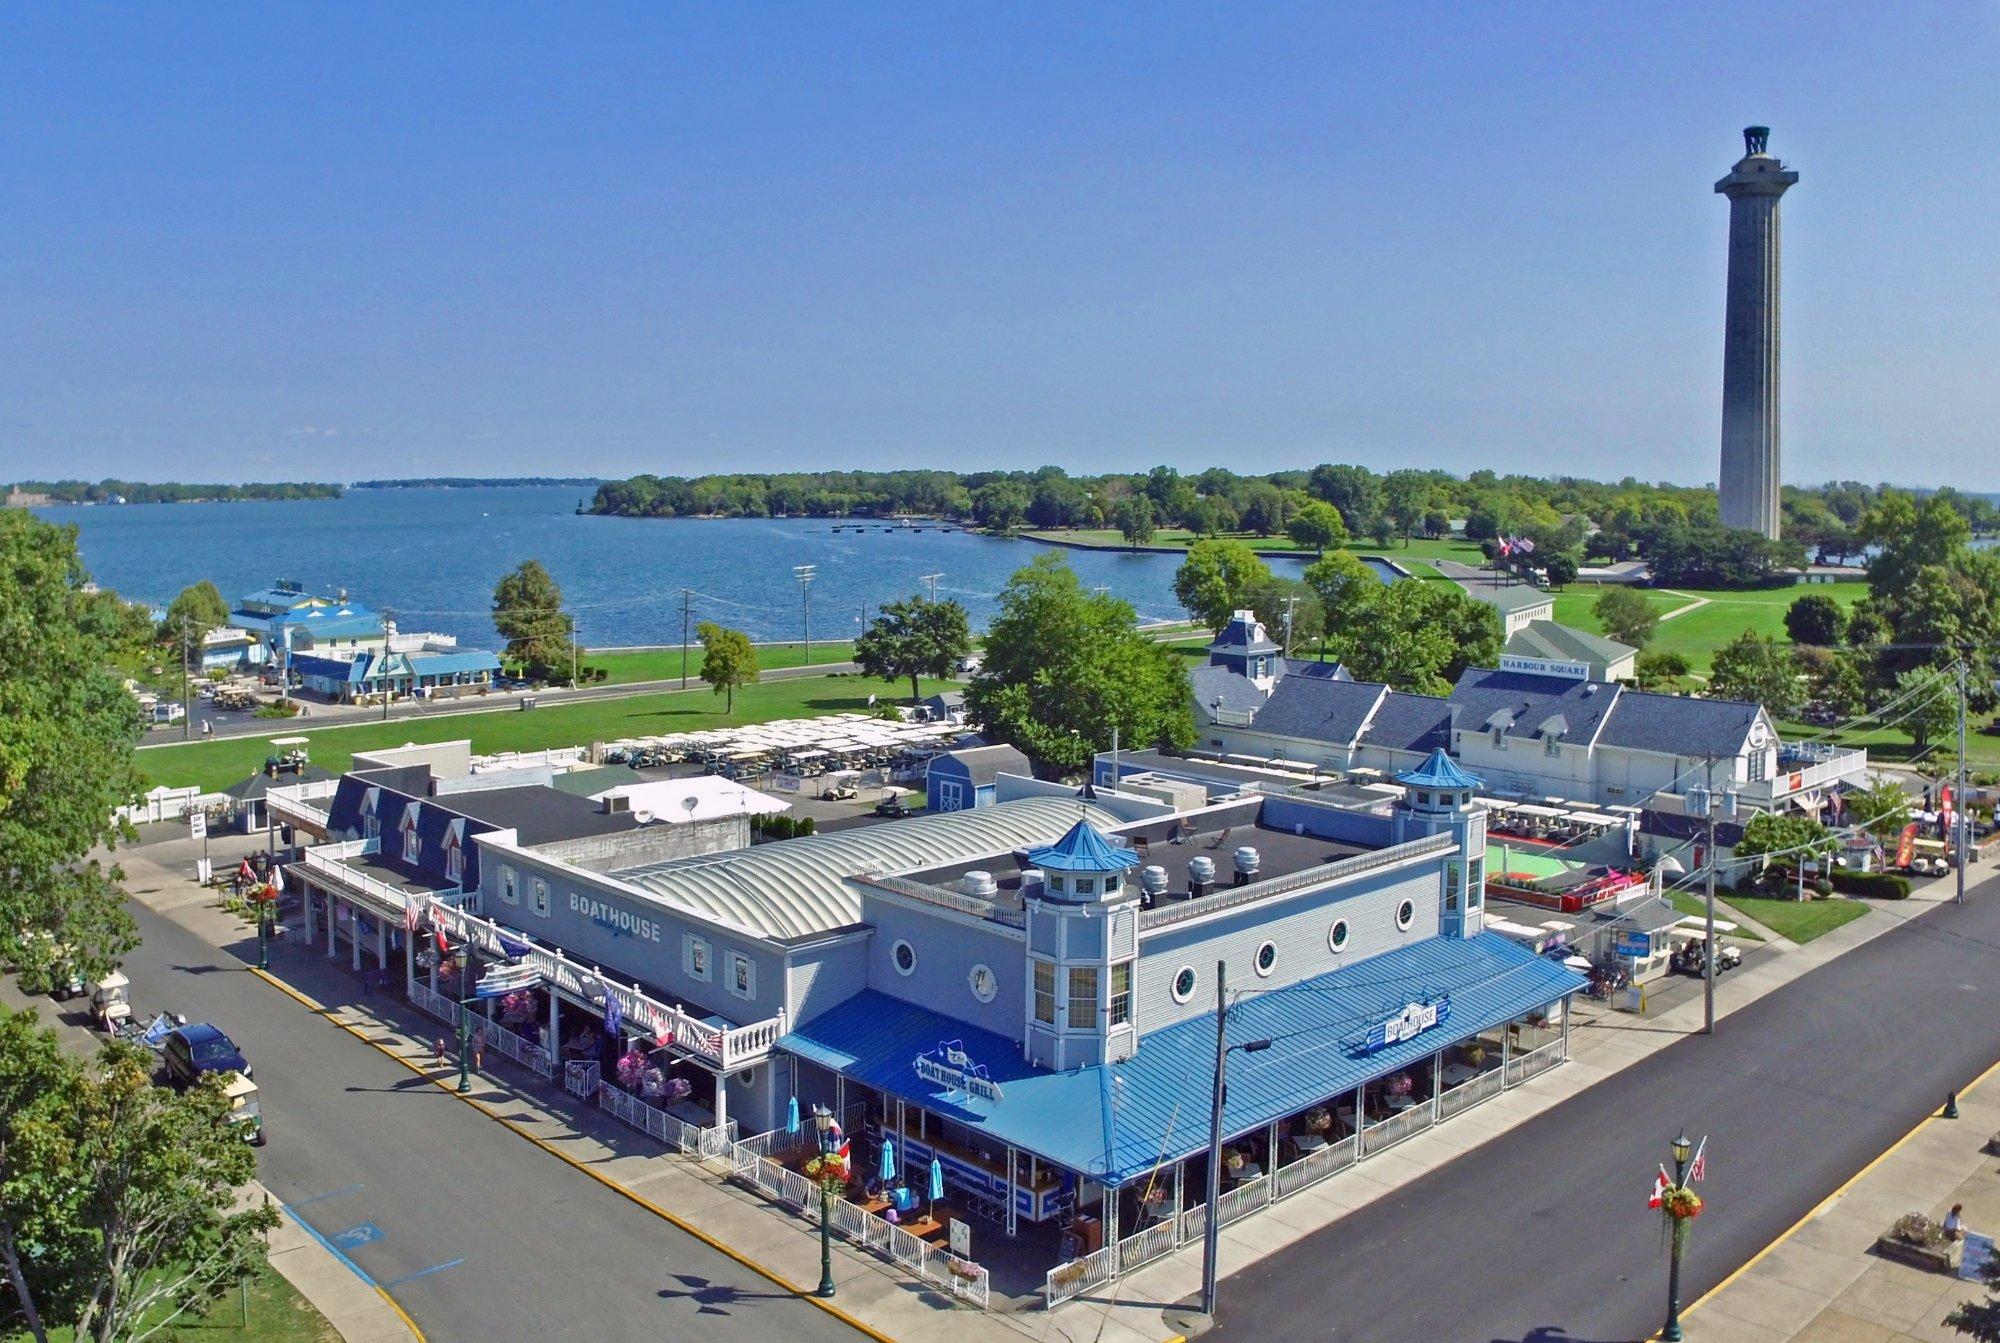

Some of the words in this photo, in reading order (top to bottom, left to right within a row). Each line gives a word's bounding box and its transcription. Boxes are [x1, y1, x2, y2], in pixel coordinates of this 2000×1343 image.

[1503, 660, 1546, 672] HARBOUR
[1550, 664, 1585, 676] SQUARE
[570, 892, 661, 943] BOATHOUSE
[1387, 1009, 1434, 1039] BOATHOUSE
[920, 1061, 967, 1090] BOATHOUSE
[969, 1081, 995, 1101] GRILL
